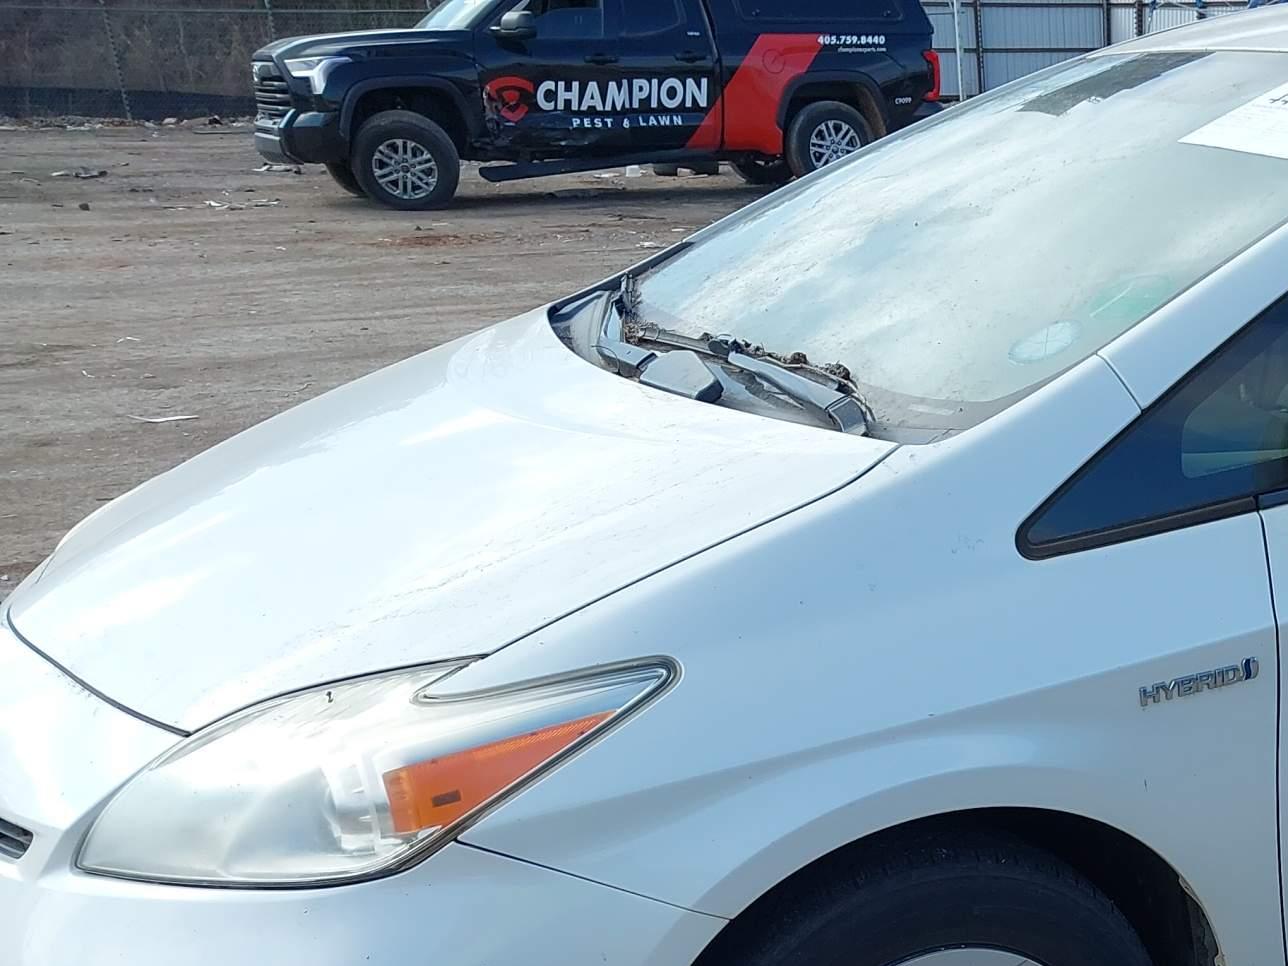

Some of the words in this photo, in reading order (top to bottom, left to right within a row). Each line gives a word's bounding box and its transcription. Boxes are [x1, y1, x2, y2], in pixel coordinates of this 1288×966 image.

[817, 35, 886, 45] 405.759.8440
[536, 77, 708, 112] CHAMPION
[571, 117, 614, 129] PEST
[622, 117, 631, 129] &
[638, 115, 683, 126] LAWN
[1139, 664, 1243, 707] HYBRID
